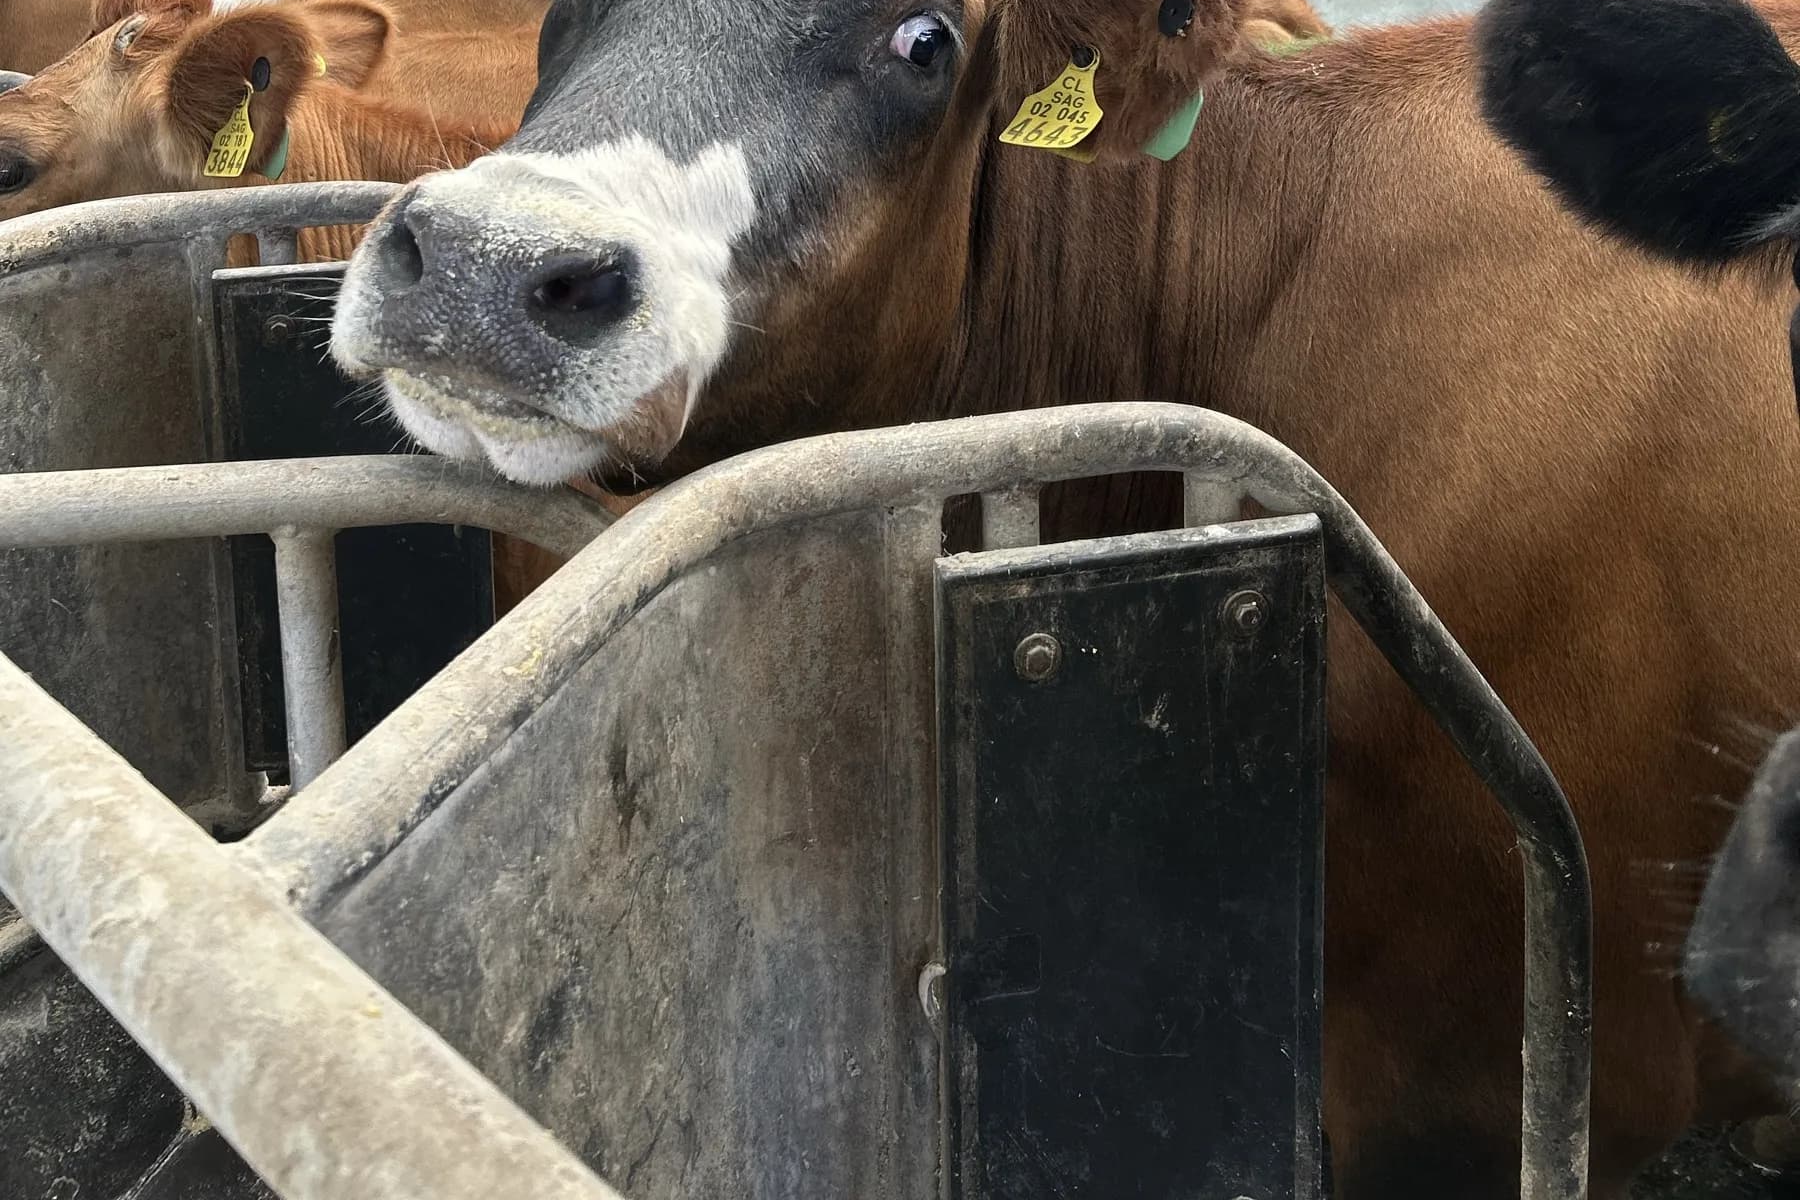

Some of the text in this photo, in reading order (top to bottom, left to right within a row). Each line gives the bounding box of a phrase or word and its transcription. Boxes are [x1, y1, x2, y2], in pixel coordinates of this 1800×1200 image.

[1062, 76, 1085, 94] CL
[1051, 91, 1085, 108] SAG
[1030, 101, 1089, 124] 02 045
[230, 123, 246, 133] SAG
[1007, 118, 1088, 145] 4643
[219, 134, 231, 147] 02
[208, 149, 247, 174] 3844
